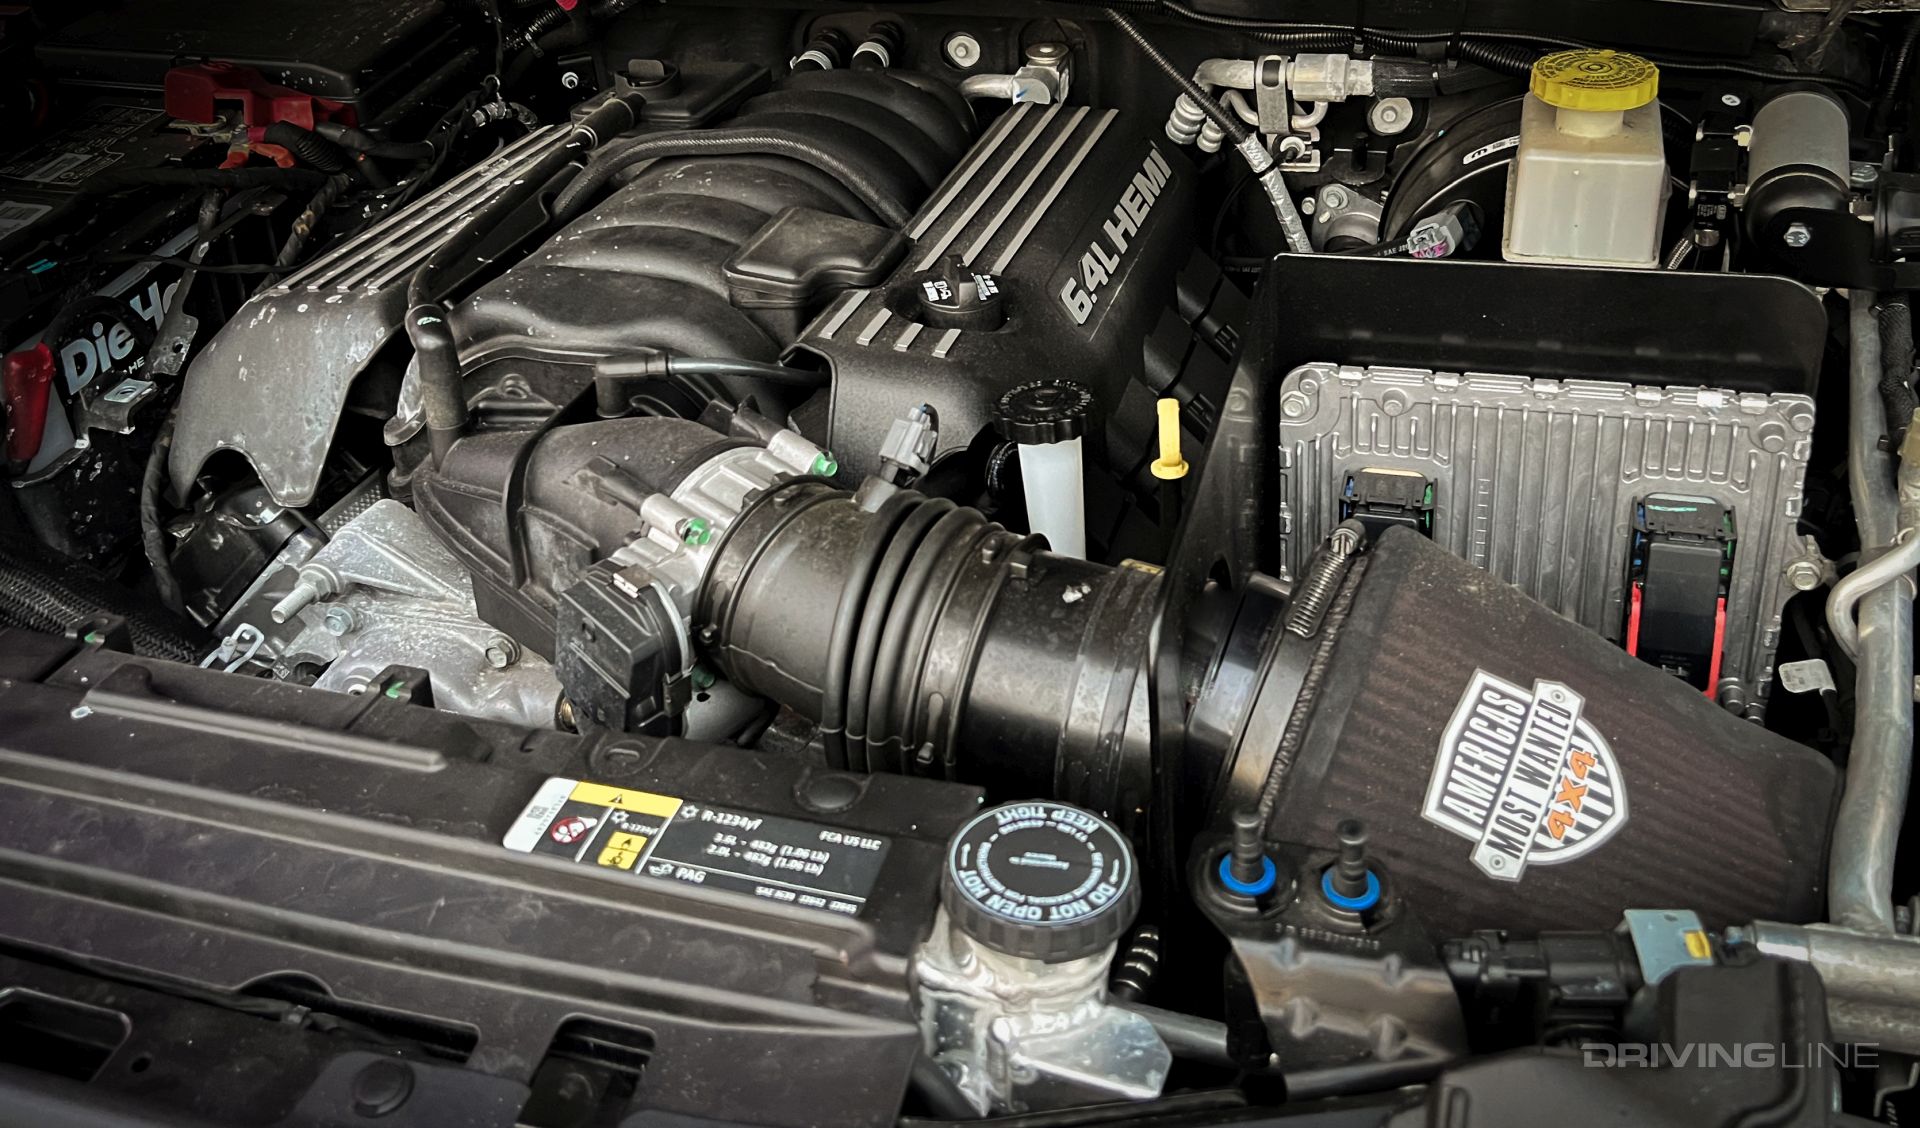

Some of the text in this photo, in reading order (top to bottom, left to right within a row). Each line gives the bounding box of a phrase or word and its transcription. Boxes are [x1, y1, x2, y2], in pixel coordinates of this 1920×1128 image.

[1060, 148, 1172, 325] 6.4L HEMI
[1441, 688, 1528, 825] AMERICAS
[1486, 698, 1573, 861] MOST WANTED
[700, 809, 764, 832] R-1234yf
[994, 806, 1047, 826] TIGHT
[1050, 809, 1100, 835] KEEP
[818, 830, 882, 851] FCA US LLC
[675, 866, 707, 884] PAG
[957, 869, 991, 899] HOT
[1087, 882, 1117, 906] DO
[985, 894, 1043, 921] OPEN
[1048, 899, 1092, 920] NOT
